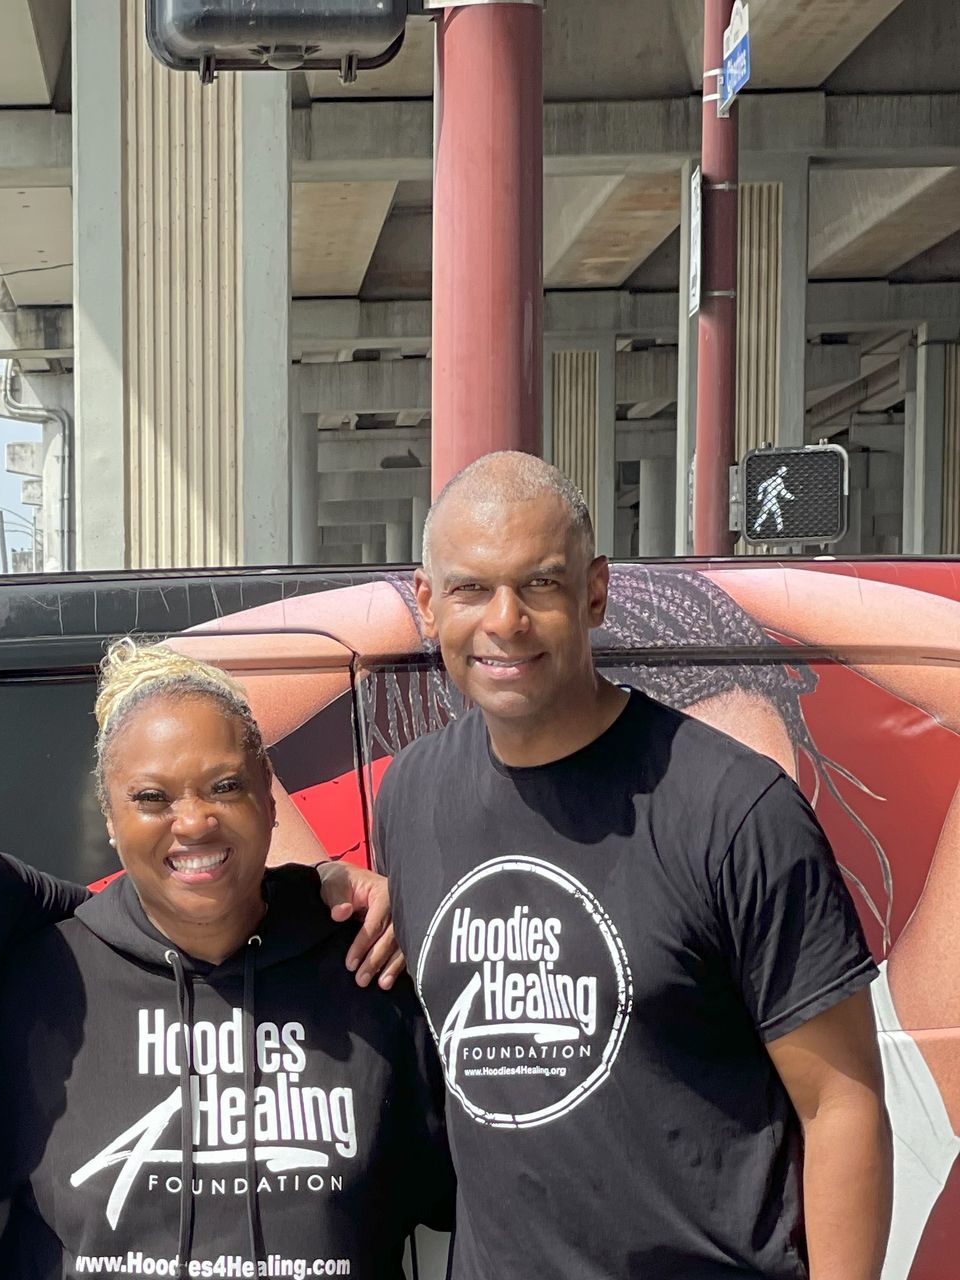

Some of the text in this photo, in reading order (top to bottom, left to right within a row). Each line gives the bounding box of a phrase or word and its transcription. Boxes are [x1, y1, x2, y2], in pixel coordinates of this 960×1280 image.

[450, 905, 562, 963] Hoodies
[138, 1007, 306, 1075] Hoodes
[438, 960, 598, 1090] 4 Healing
[462, 1045, 591, 1061] FOUNDATION
[464, 1065, 567, 1077] www.Hoodies4Healing.org
[69, 1072, 358, 1231] 4 Healing
[148, 1173, 343, 1195] FOUNDATION
[75, 1251, 351, 1280] www.Hoodes4Healing.com
